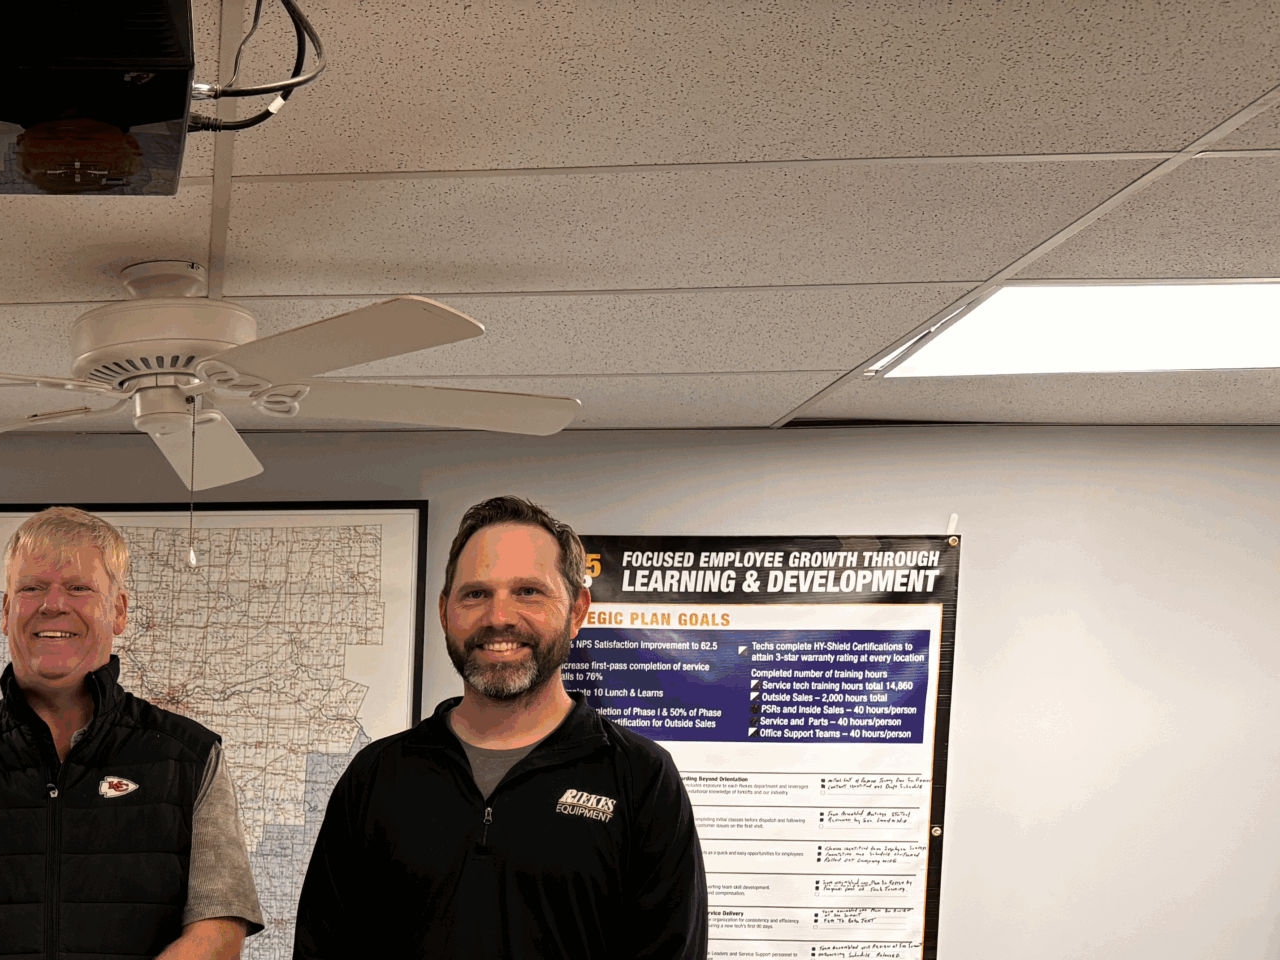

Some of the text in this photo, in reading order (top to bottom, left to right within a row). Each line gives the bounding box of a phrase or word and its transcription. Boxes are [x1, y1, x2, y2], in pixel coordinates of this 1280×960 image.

[622, 551, 939, 567] FOCUSED EMPLOYEE GROWTH THROUGH
[622, 569, 939, 592] LEARNING & DEVELOPMENT
[630, 612, 730, 626] PLAN GOALS
[576, 640, 717, 651] NPS Satisfaction Improvement 62.5
[752, 642, 903, 652] Techs complete HY-Shield Certifications
[801, 655, 834, 663] warranty
[837, 654, 858, 663] rating
[869, 655, 891, 663] every
[893, 654, 924, 662] location
[592, 662, 627, 671] first-pass
[629, 662, 671, 671] completion
[751, 669, 792, 678] Completed
[835, 670, 863, 679] training
[762, 681, 839, 691] Service training
[605, 689, 663, 697] Lunch Learns
[762, 693, 792, 701] Outside
[633, 708, 722, 717] Phase Phase
[761, 705, 916, 715] PSRs Inside hours/person
[665, 719, 693, 728] Outside
[760, 717, 901, 727] Service Parts hours/person
[760, 729, 782, 737] Office
[784, 730, 813, 739] Support
[862, 730, 911, 739] hours/person
[559, 789, 617, 812] RIEKES
[556, 804, 612, 822] EQUIPMENT
